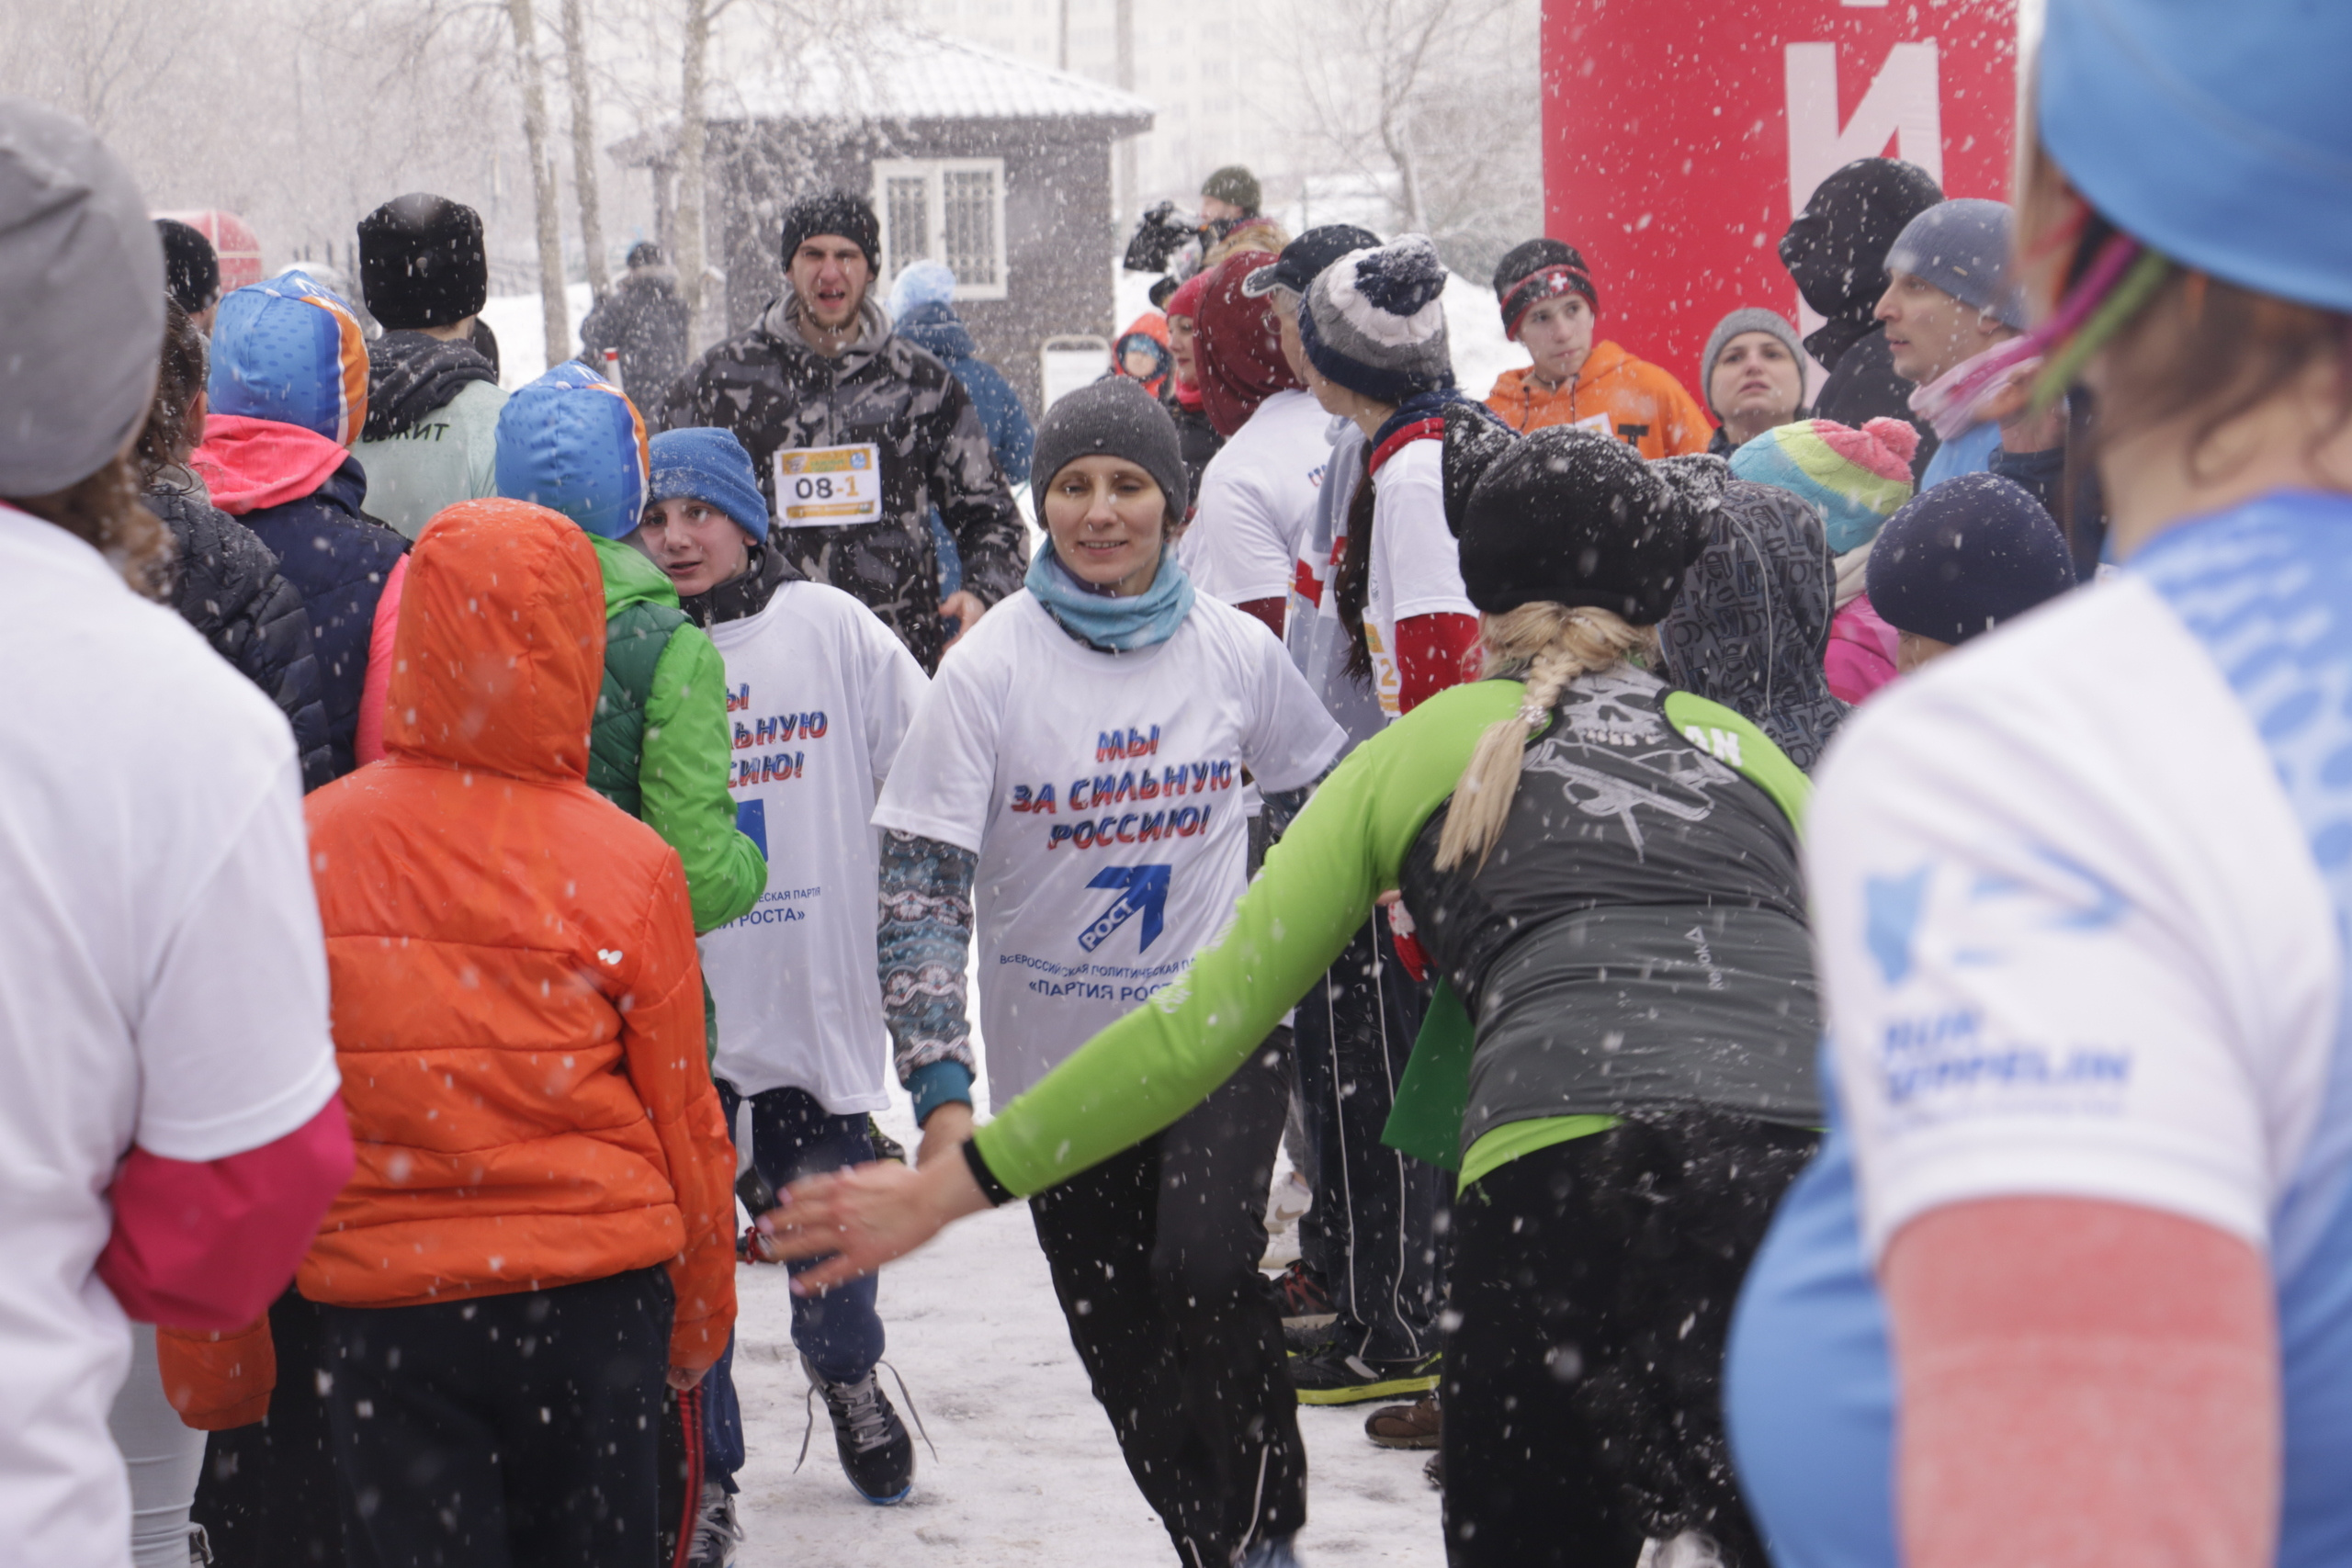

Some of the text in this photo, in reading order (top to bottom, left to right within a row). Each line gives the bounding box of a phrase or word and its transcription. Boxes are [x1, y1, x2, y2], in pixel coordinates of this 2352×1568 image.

[796, 475, 860, 500] 08-1
[726, 682, 751, 712] Ы
[729, 710, 828, 750] ЬНУЮ
[1095, 724, 1160, 762] МЫ
[1011, 759, 1232, 815] ЗА СИЛЬНУЮ
[1047, 804, 1212, 851] РОССИЮ!
[1080, 897, 1133, 950] РОСТ
[1000, 953, 1090, 978] ВСЕРОССИЙСКАЯ
[1091, 962, 1179, 980] ПОЛИТИЧЕСКАЯ
[1693, 942, 1724, 991] Reok
[1029, 979, 1114, 1001] «ПАРТИЯ
